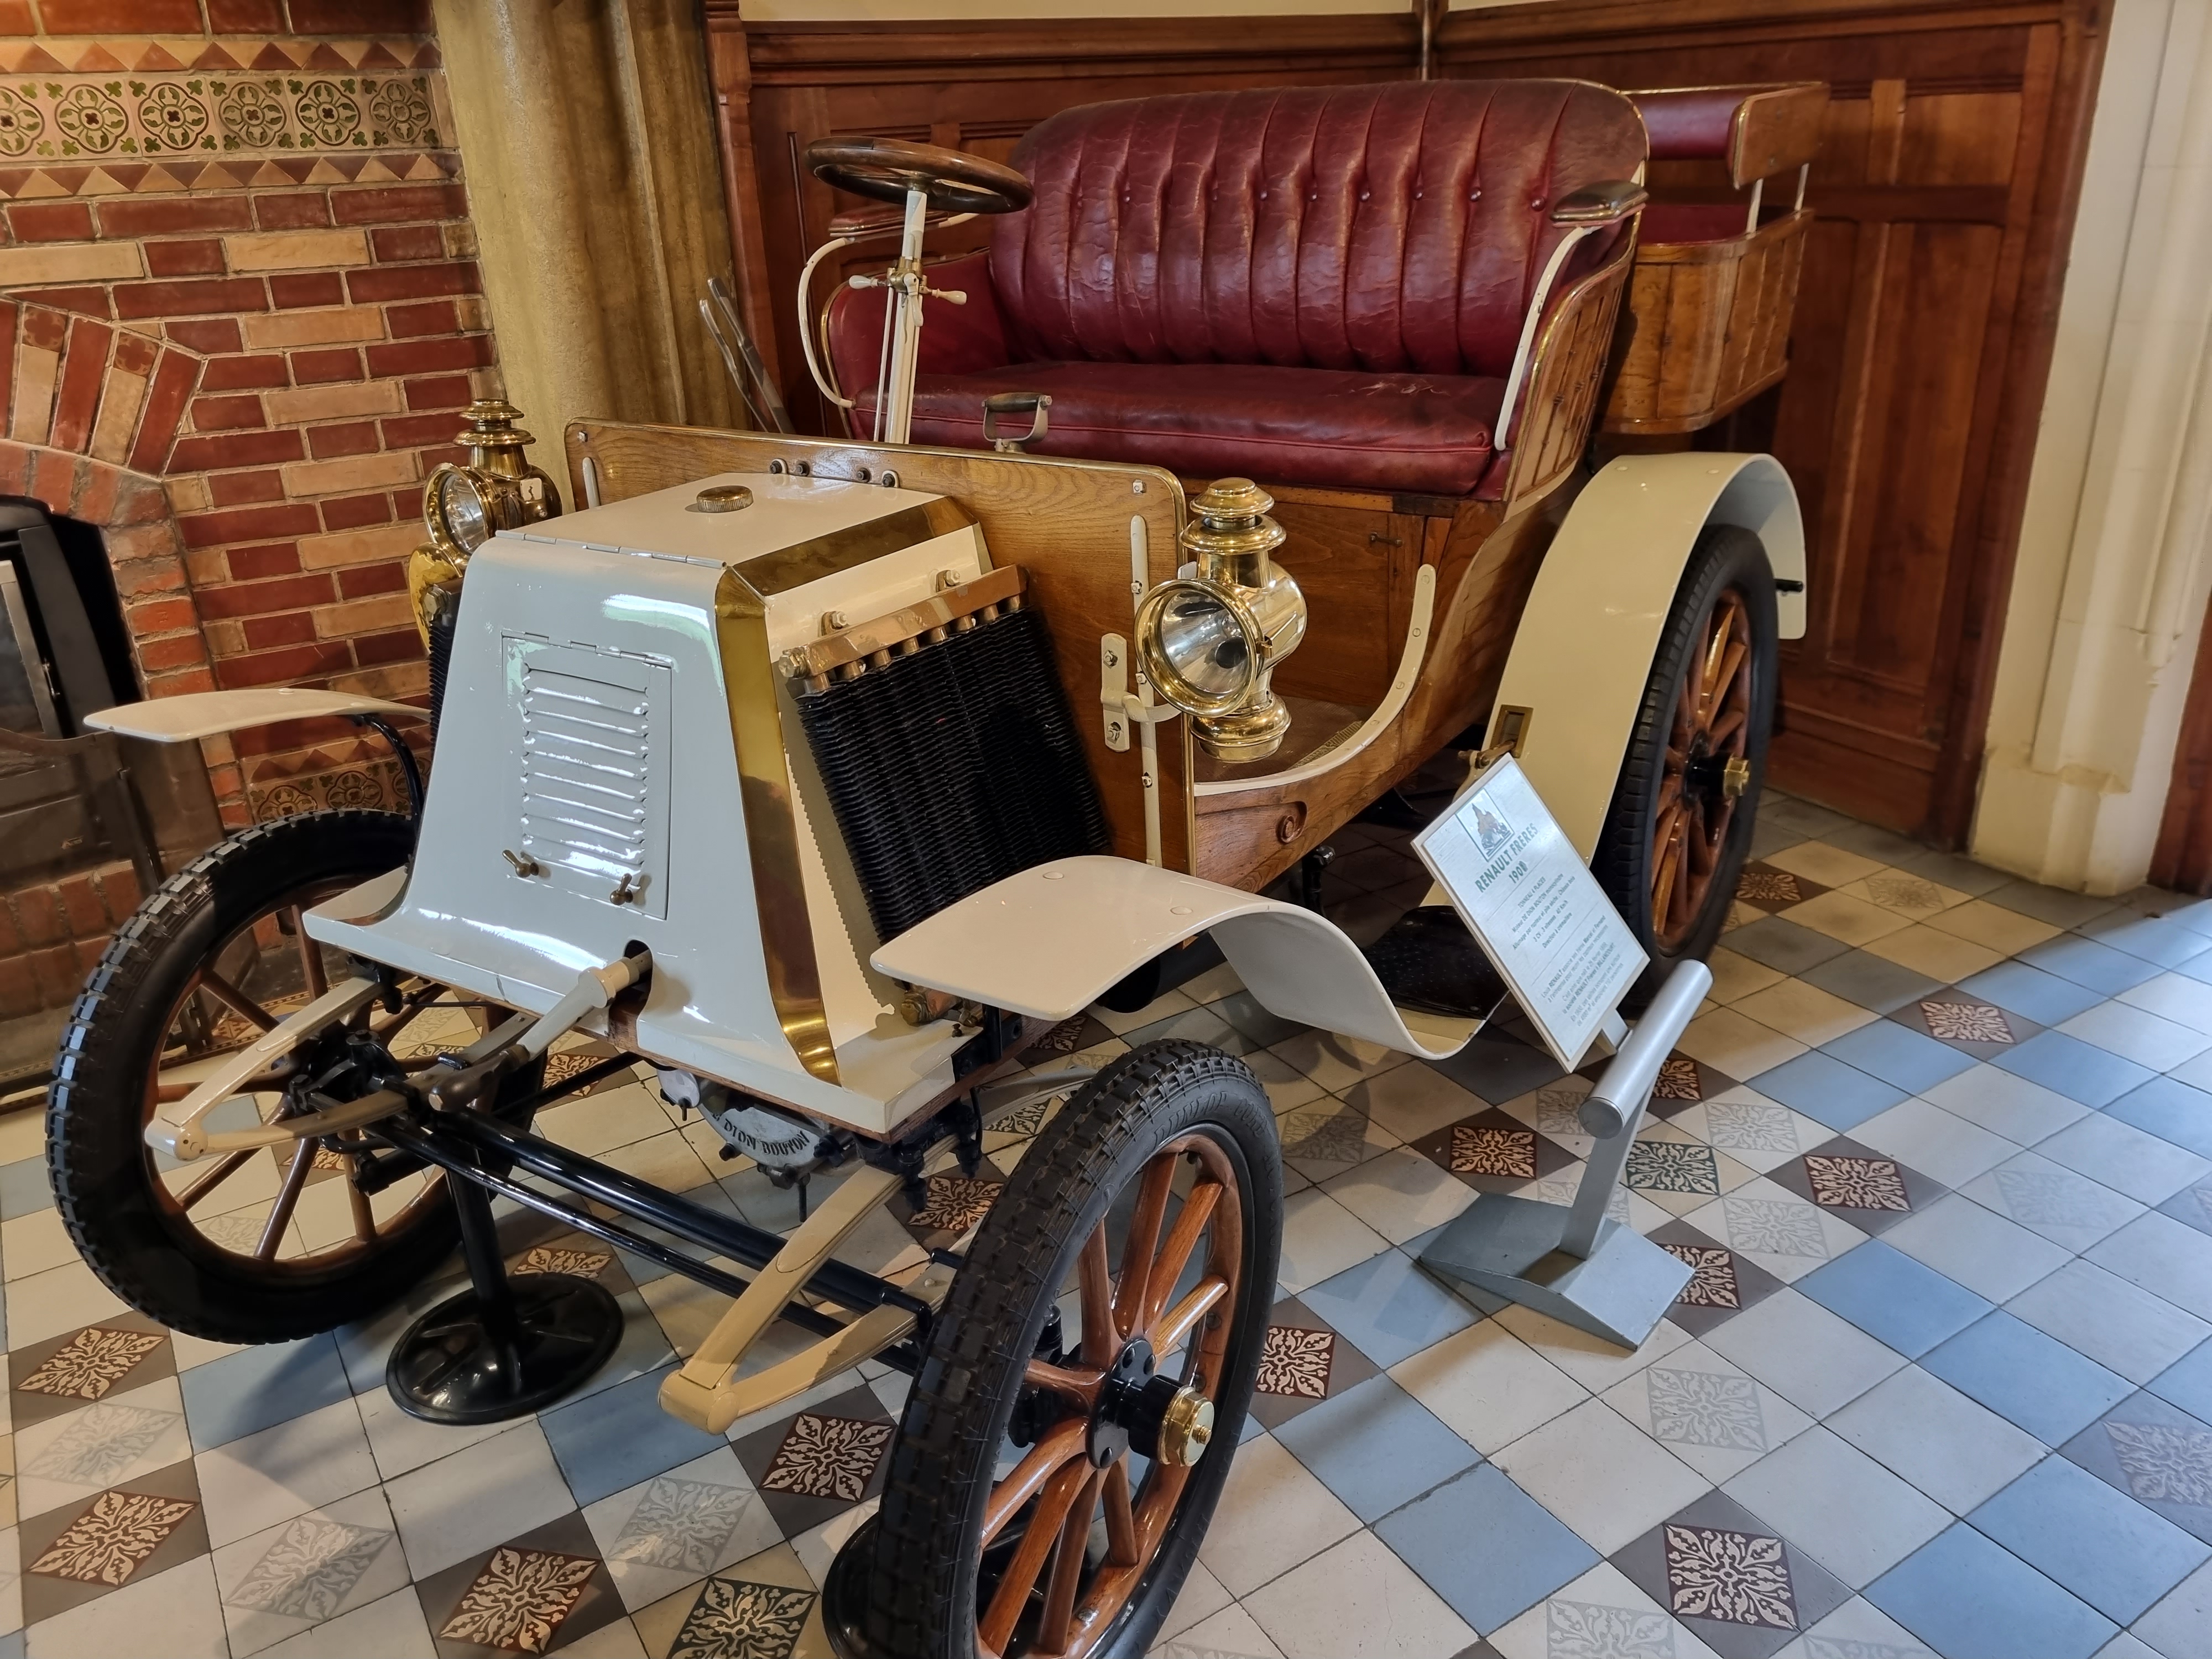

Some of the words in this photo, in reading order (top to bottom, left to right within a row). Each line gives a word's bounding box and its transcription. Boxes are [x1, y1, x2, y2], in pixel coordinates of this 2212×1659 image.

[1475, 849, 1513, 893] RENAULT
[1510, 823, 1538, 855] FRERES
[1518, 891, 1532, 909] TONNEAU
[1534, 877, 1545, 891] PLACES
[1512, 920, 1523, 932] Moteur
[1534, 892, 1546, 907] BOUTON
[1513, 932, 1527, 950] Allumage
[1543, 932, 1556, 948] Direction
[1549, 969, 1563, 988] RENAULT
[724, 1118, 757, 1150] DION
[760, 1130, 810, 1156] BOUTON
